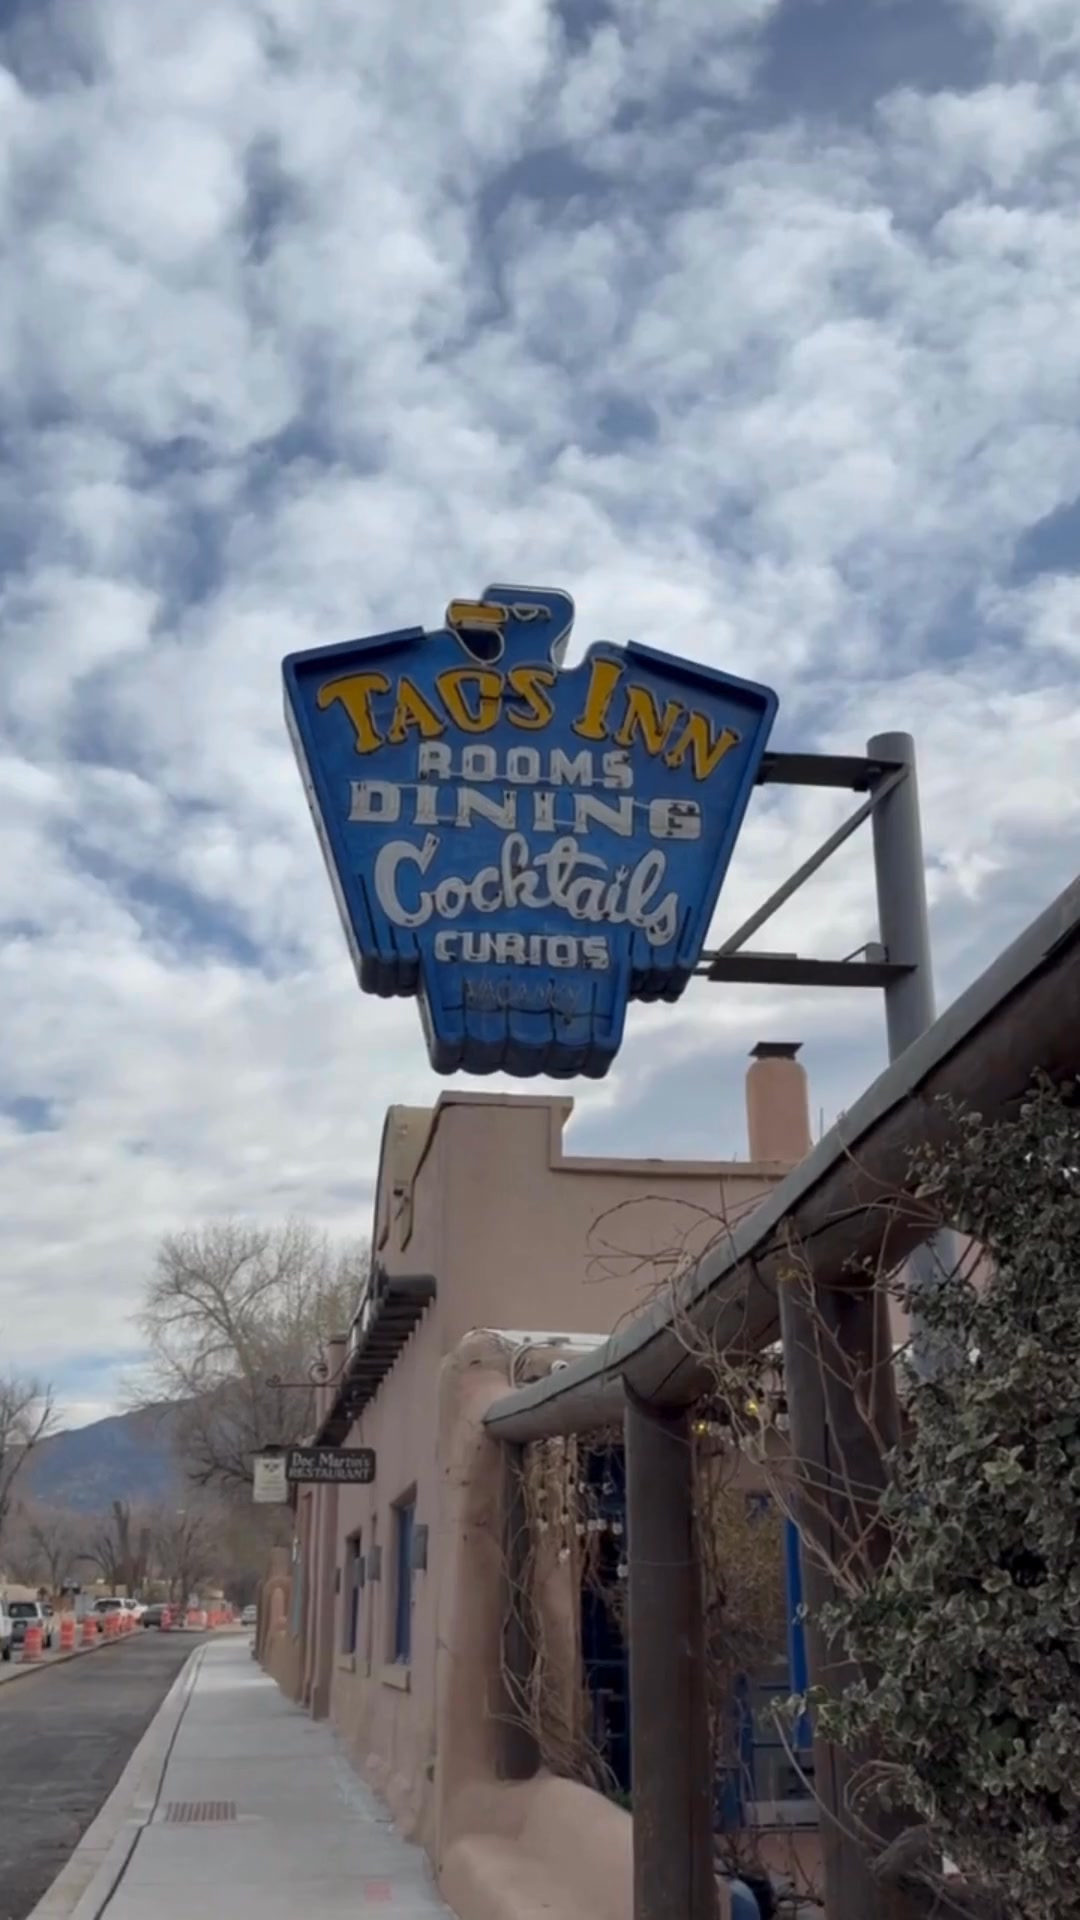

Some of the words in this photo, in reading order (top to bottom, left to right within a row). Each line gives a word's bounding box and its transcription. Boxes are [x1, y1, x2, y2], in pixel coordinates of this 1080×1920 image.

[317, 666, 557, 754] TAOS
[571, 657, 742, 782] INN
[418, 742, 634, 790] ROOMS
[348, 779, 702, 841] DINING
[373, 832, 680, 947] Cocktails
[434, 930, 611, 970] CURIOS
[288, 1467, 370, 1479] RESTAURANT
[292, 1451, 315, 1467] Doc
